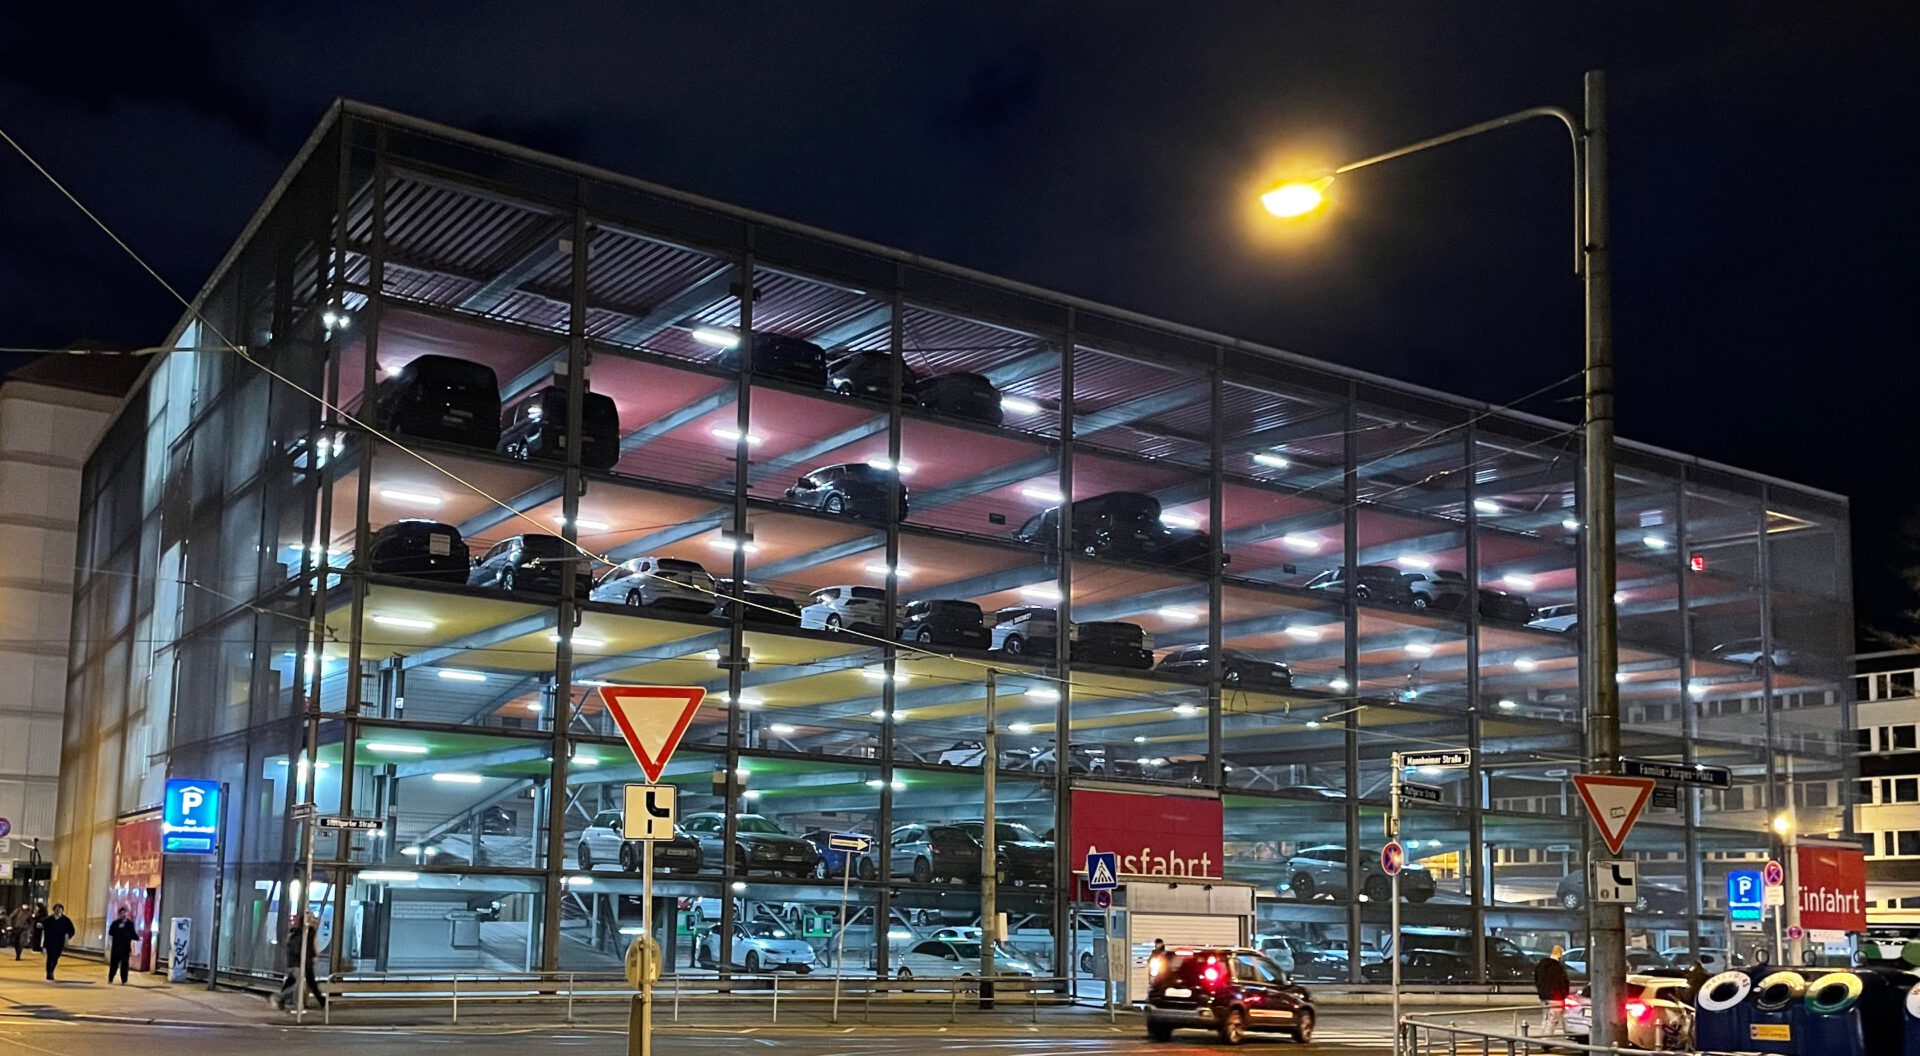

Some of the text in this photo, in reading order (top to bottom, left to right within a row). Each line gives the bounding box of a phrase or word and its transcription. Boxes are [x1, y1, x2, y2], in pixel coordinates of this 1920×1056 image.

[1407, 754, 1462, 765] Mannheimer Straße
[182, 792, 203, 815] P
[326, 819, 377, 828] Stuttgarter Straße
[1740, 880, 1752, 896] P
